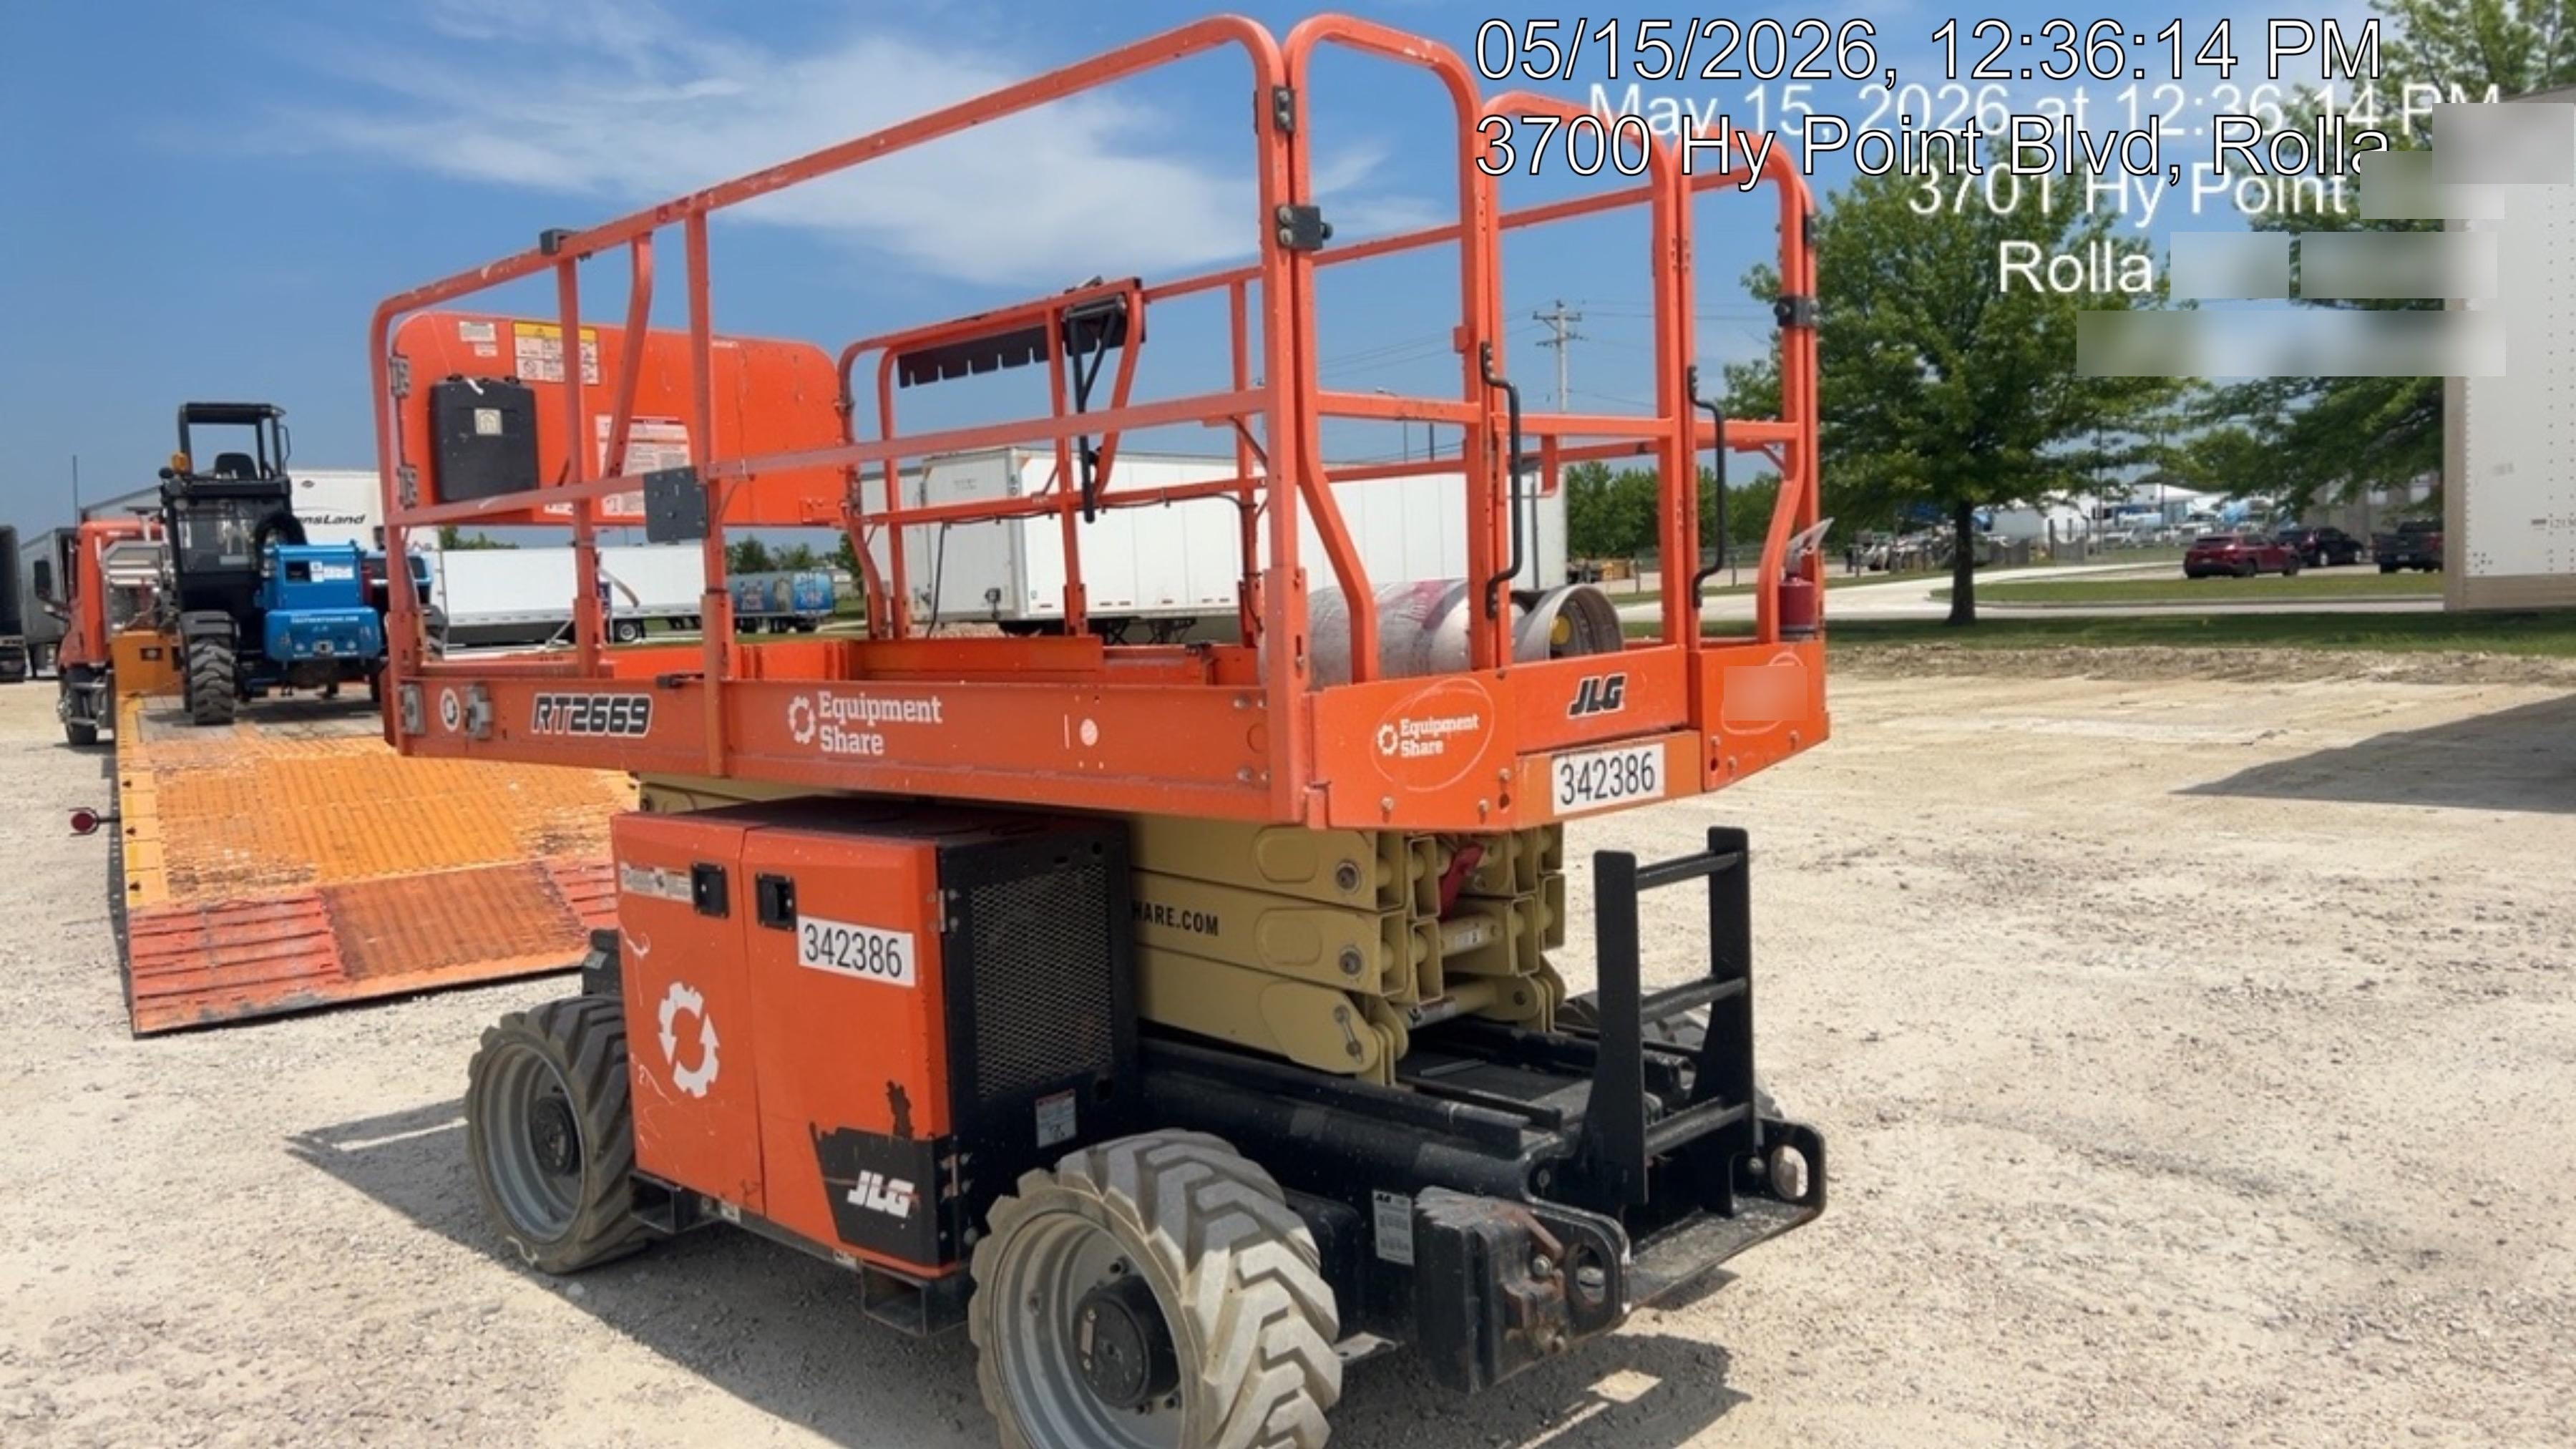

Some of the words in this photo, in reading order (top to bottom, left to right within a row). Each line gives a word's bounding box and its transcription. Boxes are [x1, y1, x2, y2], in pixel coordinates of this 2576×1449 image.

[531, 693, 653, 738] RT2669
[818, 691, 943, 727] Equipment
[1567, 672, 1628, 719] JLG
[819, 725, 884, 756] Share
[1400, 713, 1480, 740] Equipment
[1401, 738, 1444, 758] Share
[1560, 751, 1656, 806] 342386
[804, 923, 903, 978] 342386
[847, 1169, 915, 1218] JLG
